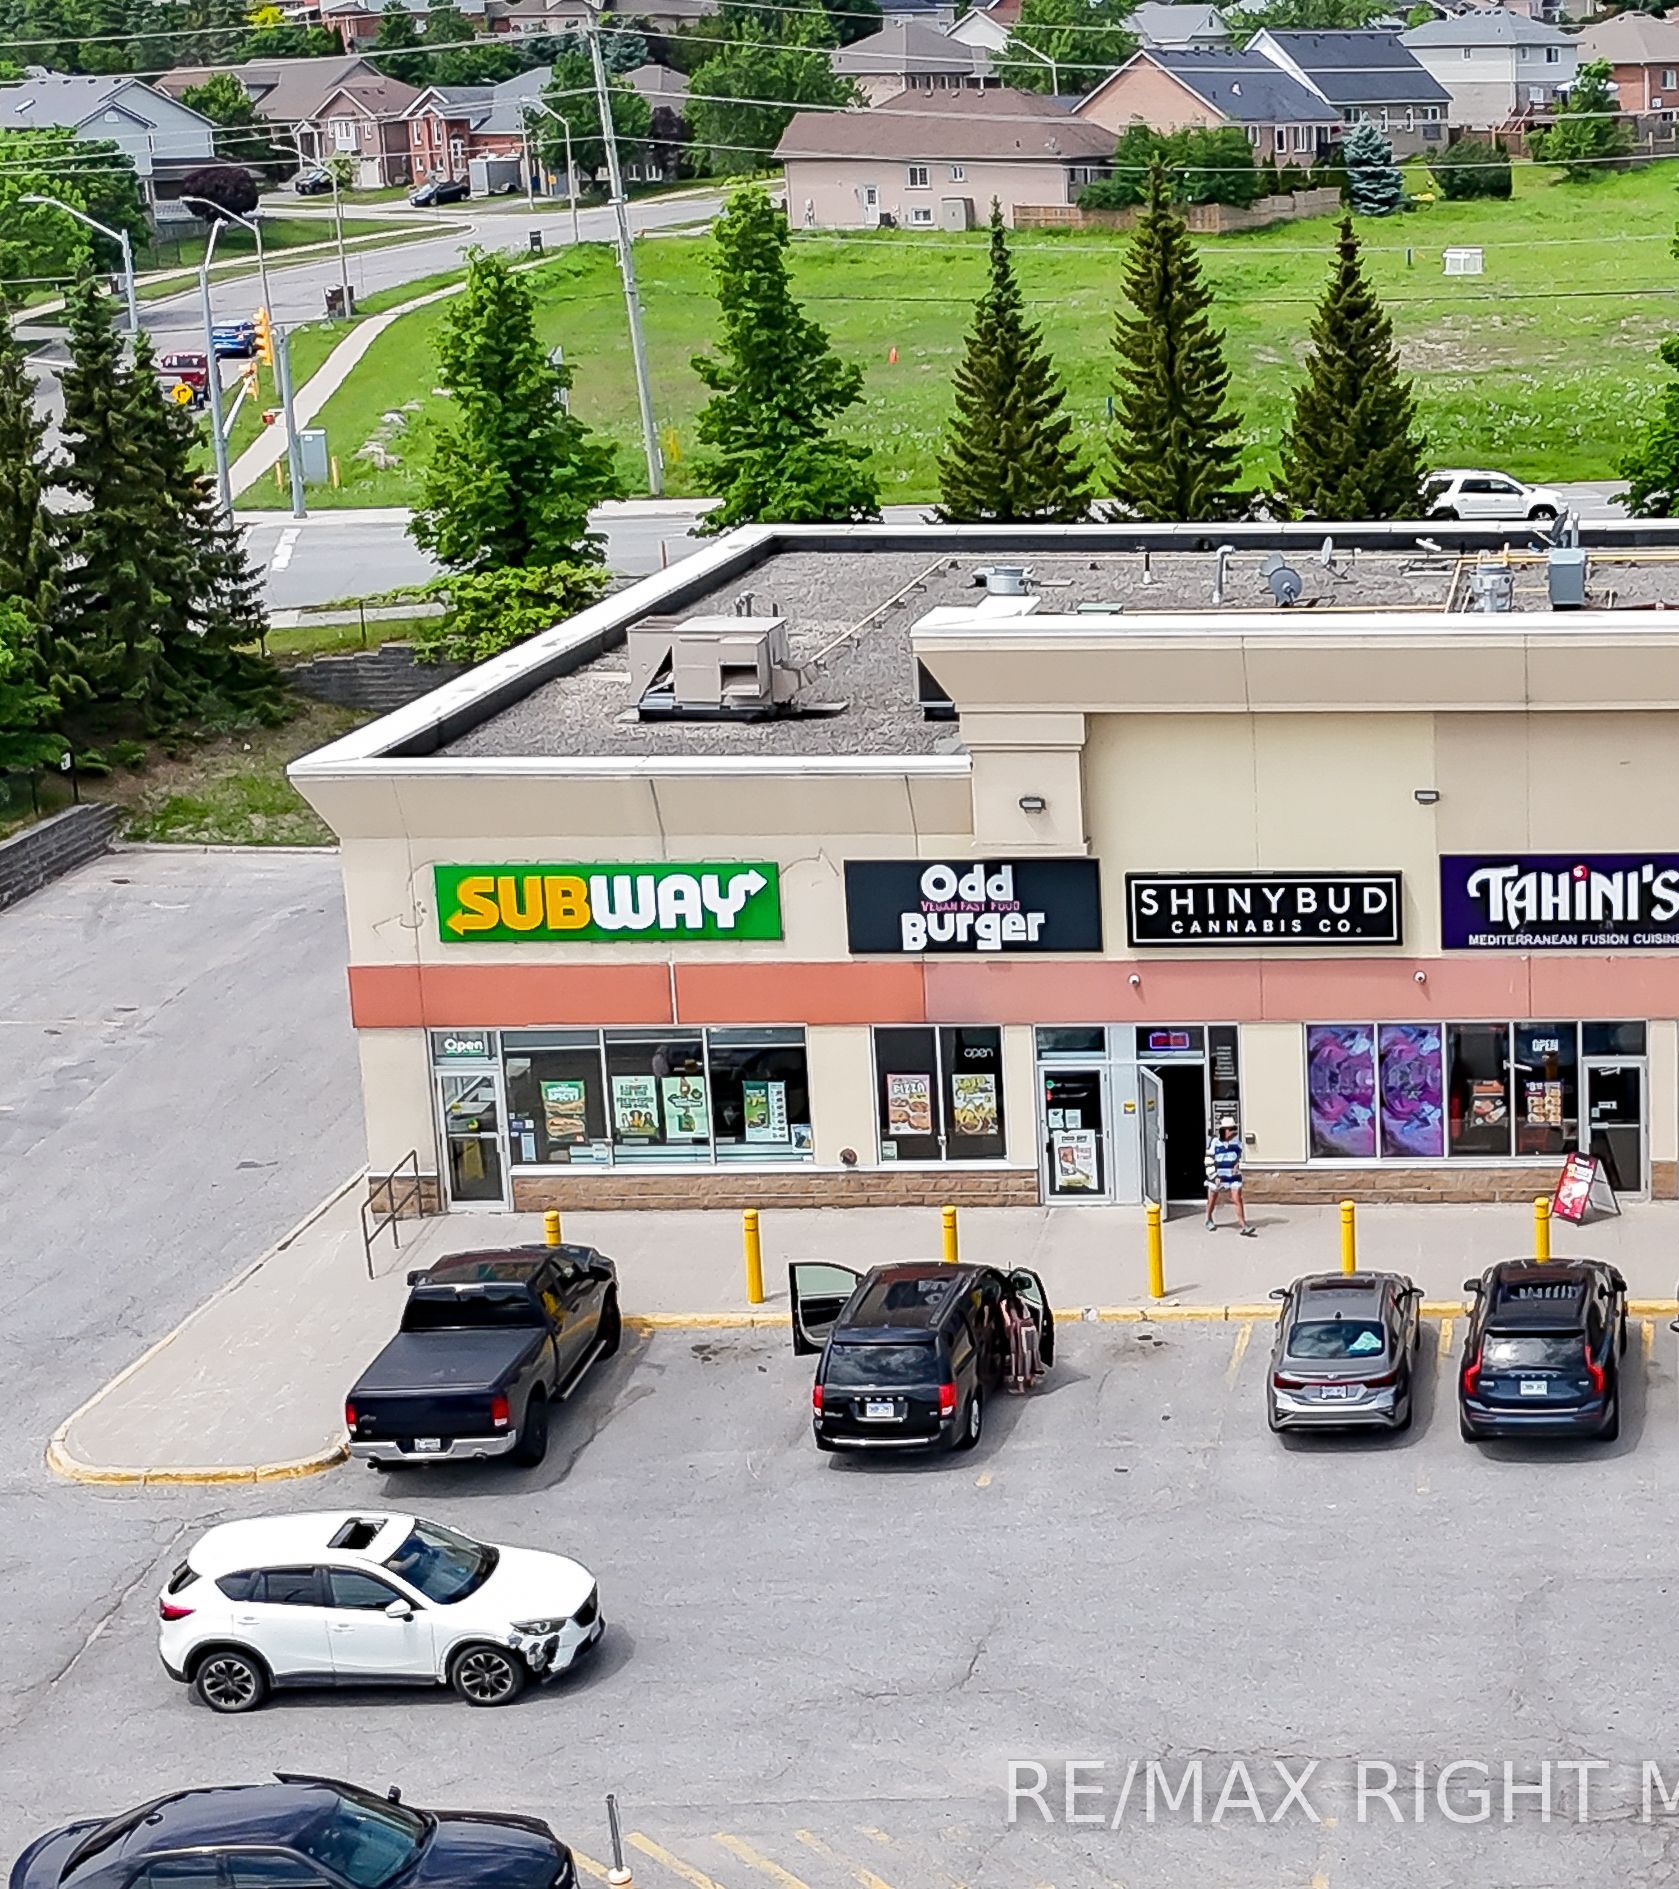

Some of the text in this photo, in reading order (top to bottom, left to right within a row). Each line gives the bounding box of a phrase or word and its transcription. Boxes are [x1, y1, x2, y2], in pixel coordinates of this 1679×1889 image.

[920, 864, 1013, 903] Odd
[446, 869, 768, 935] SUBWAY
[920, 901, 1021, 912] VEGAN FAST FOOD
[1140, 887, 1388, 915] SHINYBUD
[900, 912, 1046, 951] Burger
[1171, 919, 1363, 934] CANNABIS CO.
[1468, 934, 1578, 946] MEDITERRANEAN
[1581, 934, 1630, 945] FUSION
[444, 1038, 484, 1053] Open
[963, 1047, 994, 1059] open
